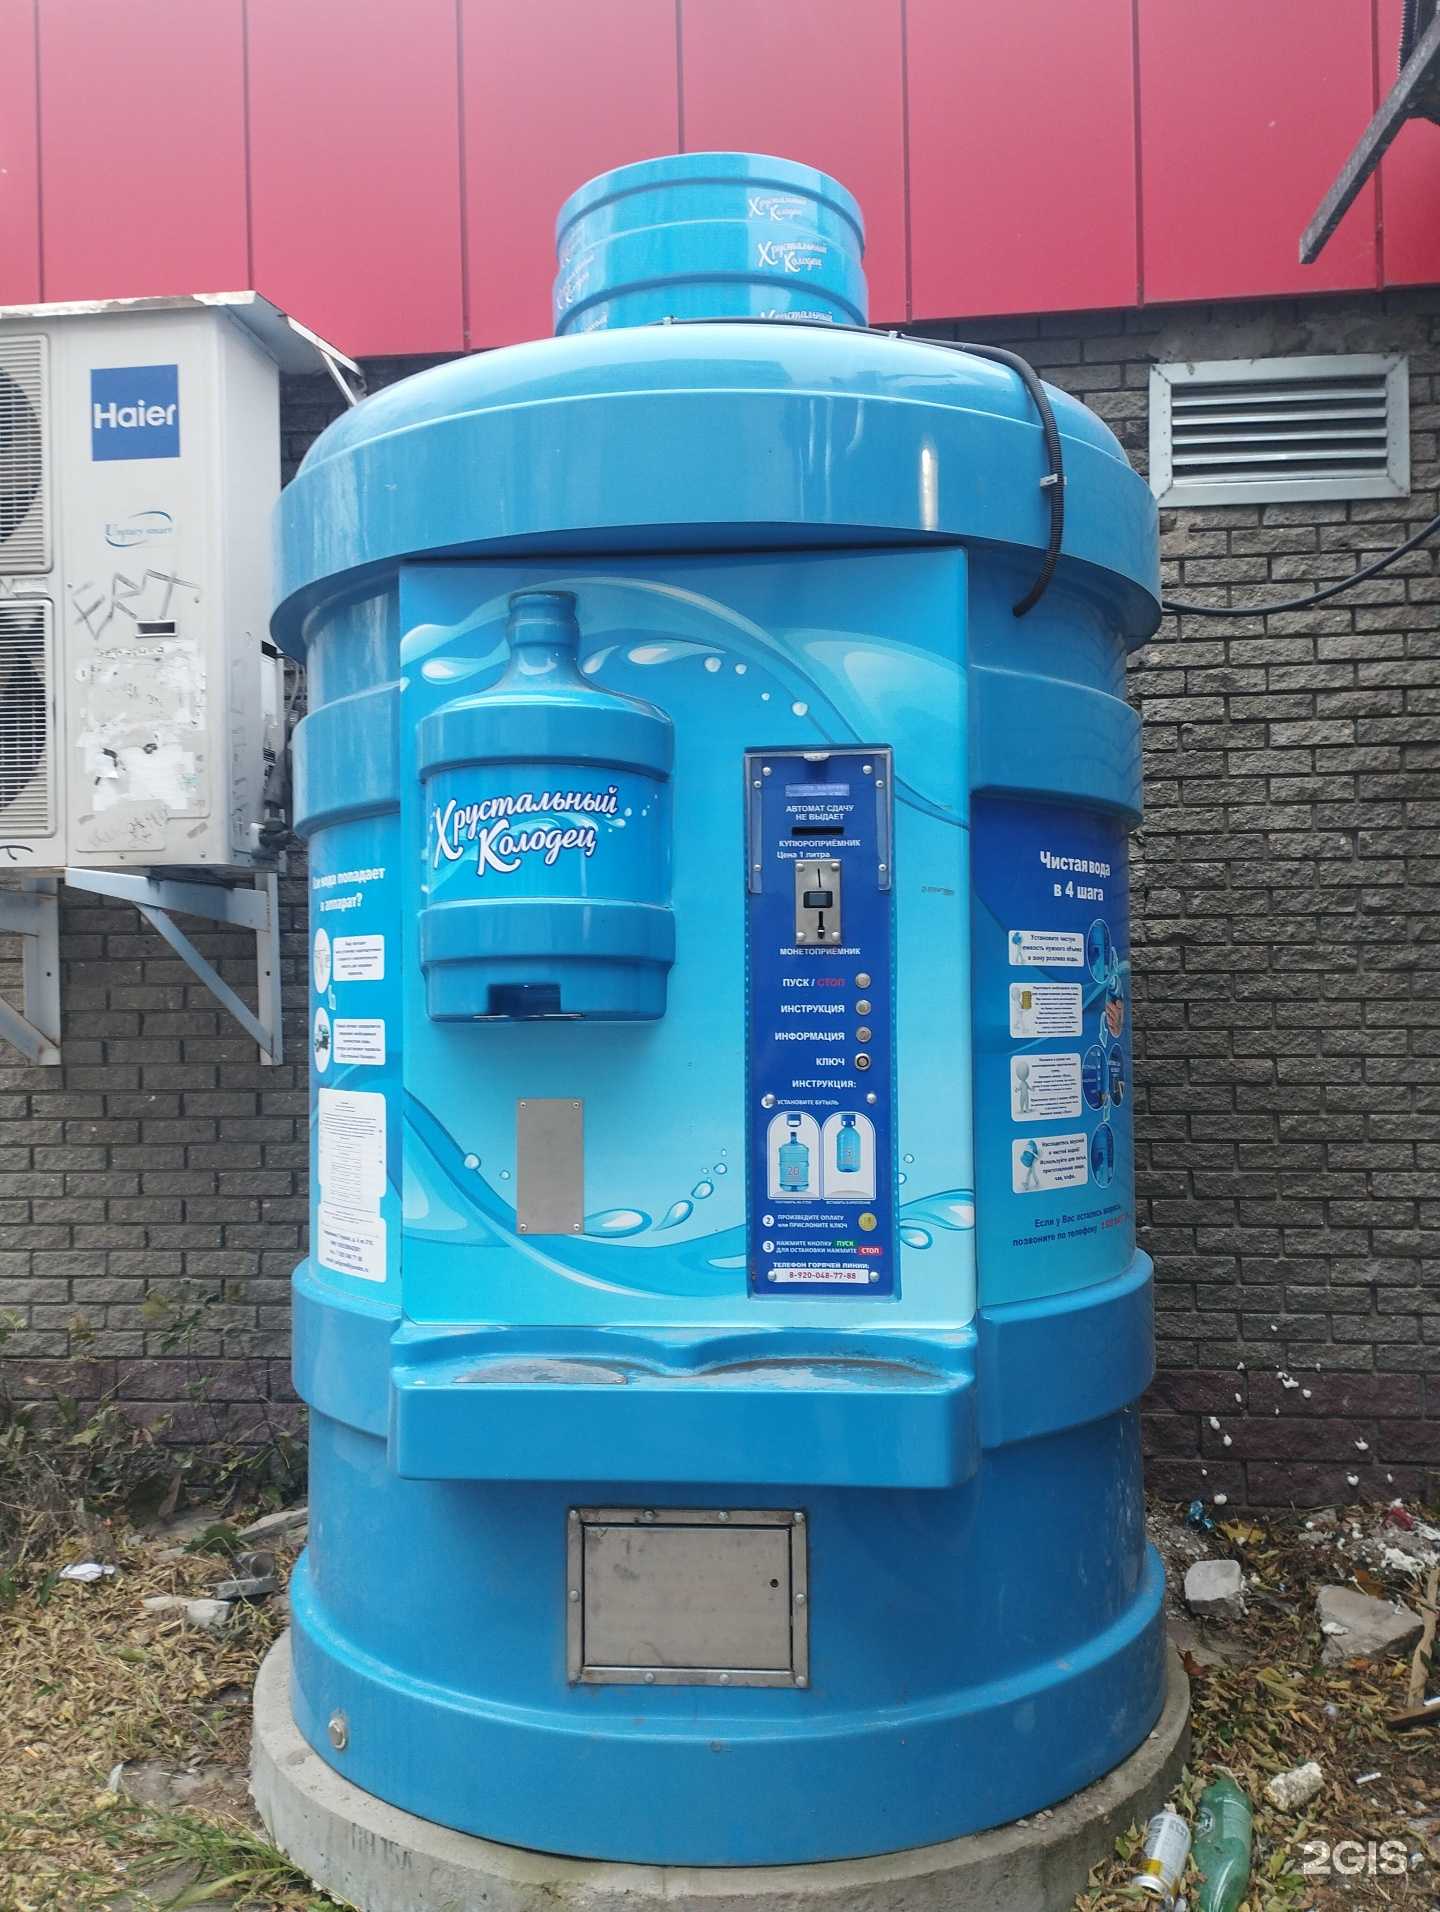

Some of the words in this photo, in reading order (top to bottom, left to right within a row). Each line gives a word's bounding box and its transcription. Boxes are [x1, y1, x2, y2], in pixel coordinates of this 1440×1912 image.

[93, 399, 177, 429] Haier
[785, 804, 826, 812] АВТОМАТ
[826, 804, 855, 812] СДАЧУ
[795, 813, 808, 821] НЕ
[809, 813, 845, 821] ВЫДАЕТ
[433, 784, 620, 869] Хрустальный
[476, 818, 597, 877] Колодец
[776, 851, 798, 859] Цена
[1040, 850, 1088, 873] Чистая
[1089, 860, 1111, 878] вода
[1053, 883, 1062, 897] в
[1065, 880, 1074, 898] 4
[1076, 886, 1104, 901] шага
[782, 978, 809, 987] ПУСК
[816, 978, 846, 987] СТОП
[780, 1004, 846, 1014] ИНСТРУКЦИЯ
[774, 1032, 846, 1042] ИНФОРМАЦИЯ
[815, 1057, 846, 1066] КЛЮЧ
[791, 1080, 857, 1089] ИНСТРУКЦИЯ:
[1034, 1218, 1054, 1228] Если
[1062, 1214, 1075, 1224] Вас
[1013, 1234, 1056, 1247] позвоните
[1057, 1232, 1067, 1240] по
